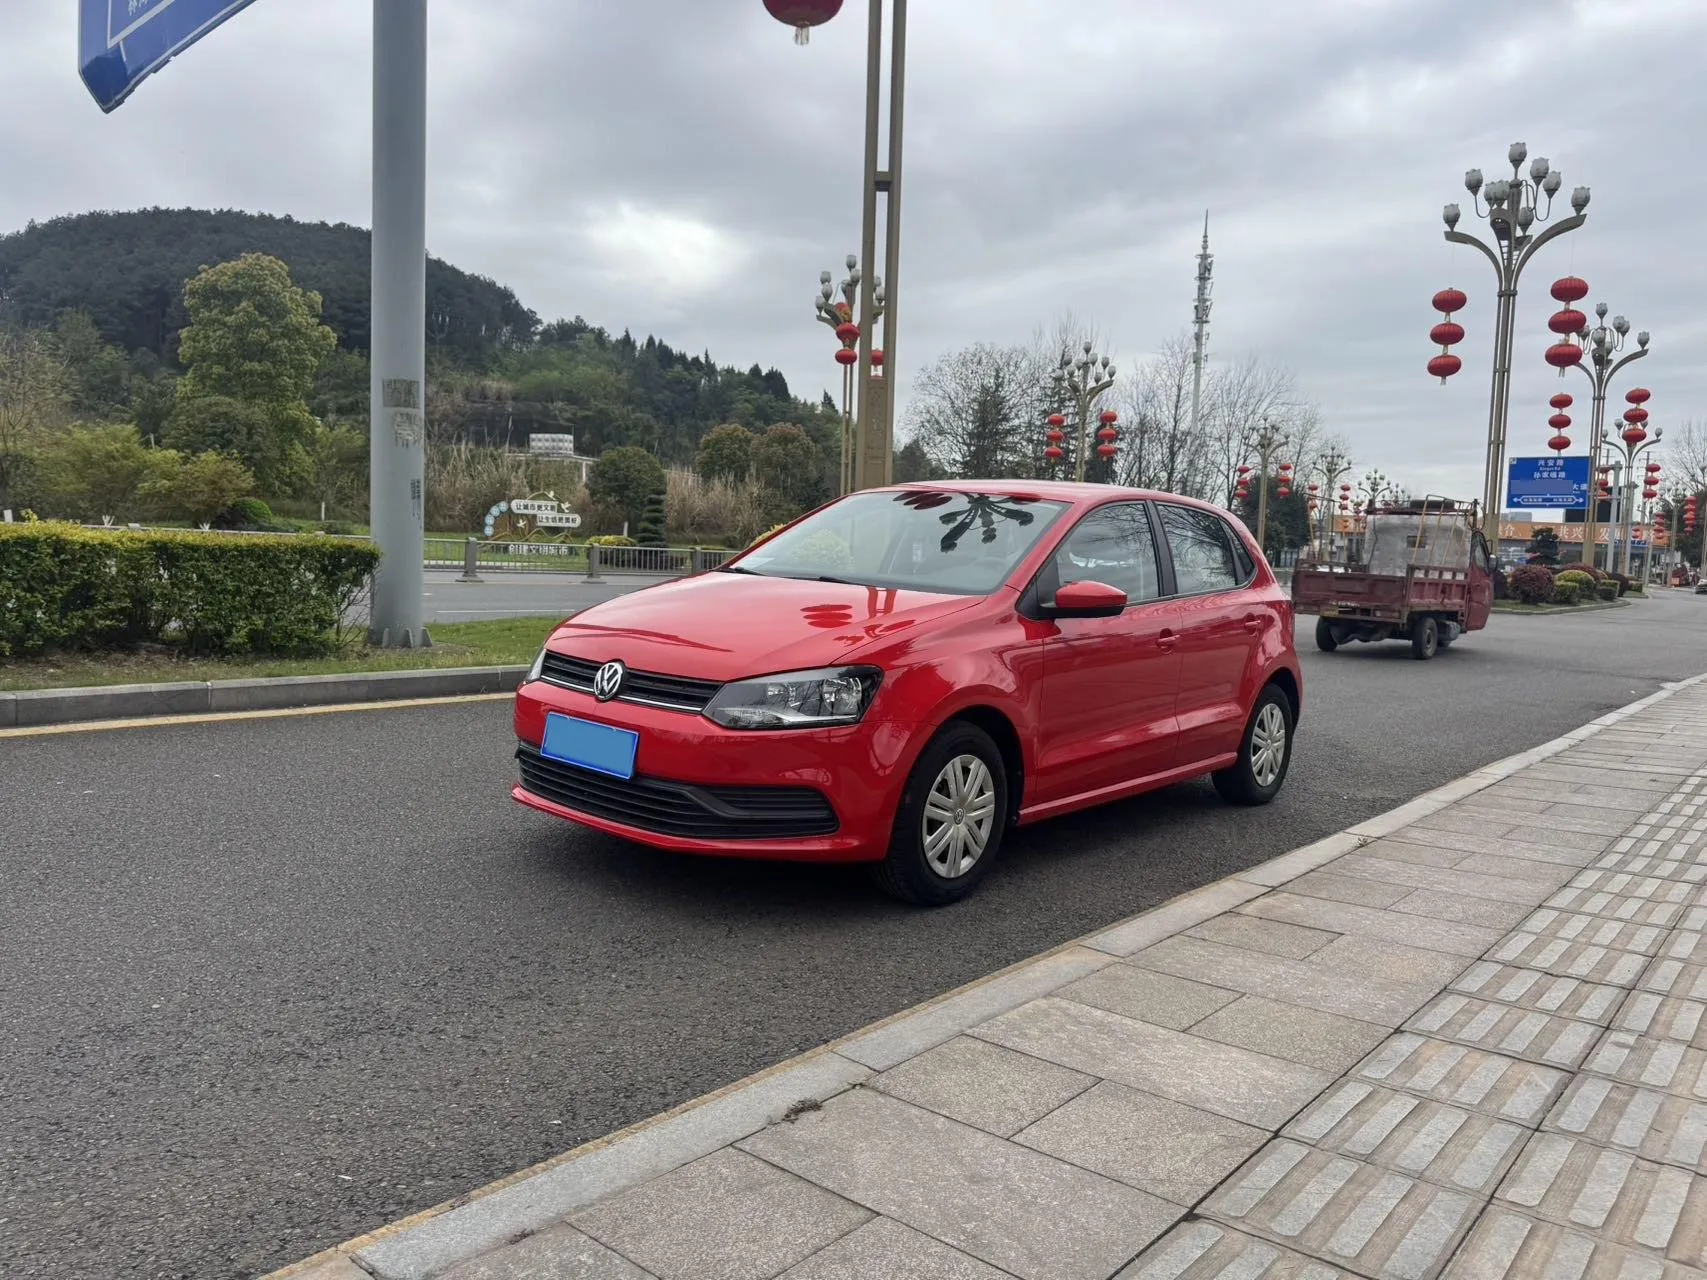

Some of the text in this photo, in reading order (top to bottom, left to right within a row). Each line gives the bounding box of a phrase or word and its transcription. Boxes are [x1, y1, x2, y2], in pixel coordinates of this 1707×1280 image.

[515, 502, 556, 513] 让城市更文明
[538, 514, 577, 524] 让生活更美好
